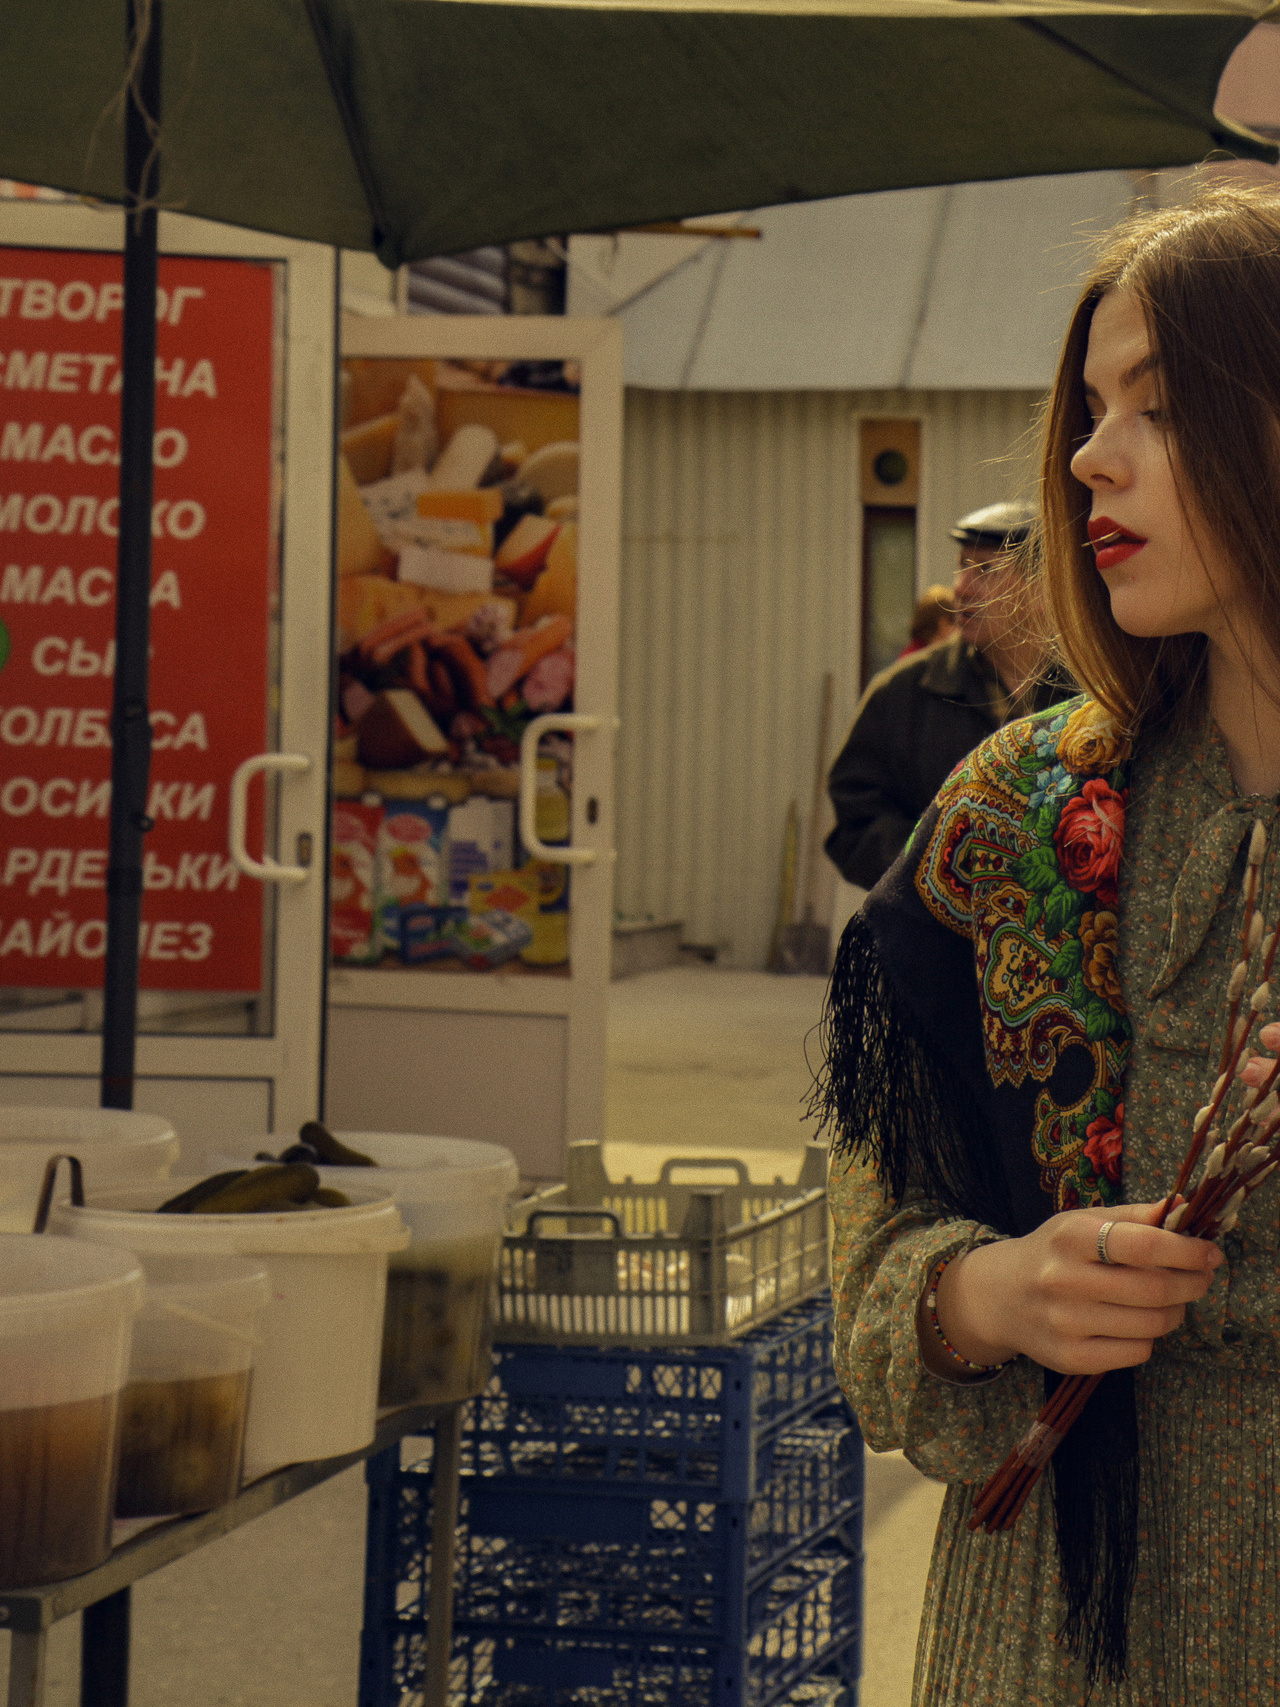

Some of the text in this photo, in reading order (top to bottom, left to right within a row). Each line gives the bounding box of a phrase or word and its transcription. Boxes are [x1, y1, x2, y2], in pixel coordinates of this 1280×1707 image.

[0, 350, 218, 399] МЕТНА
[0, 421, 189, 468] МАСО
[0, 564, 182, 609] МАСА
[32, 636, 154, 677] СЫ
[0, 706, 208, 751] ОЛБСА
[0, 776, 216, 821] ОСИКИ
[2, 847, 241, 896] РДЕЬКИ
[0, 909, 214, 961] АЙОЕЗ
